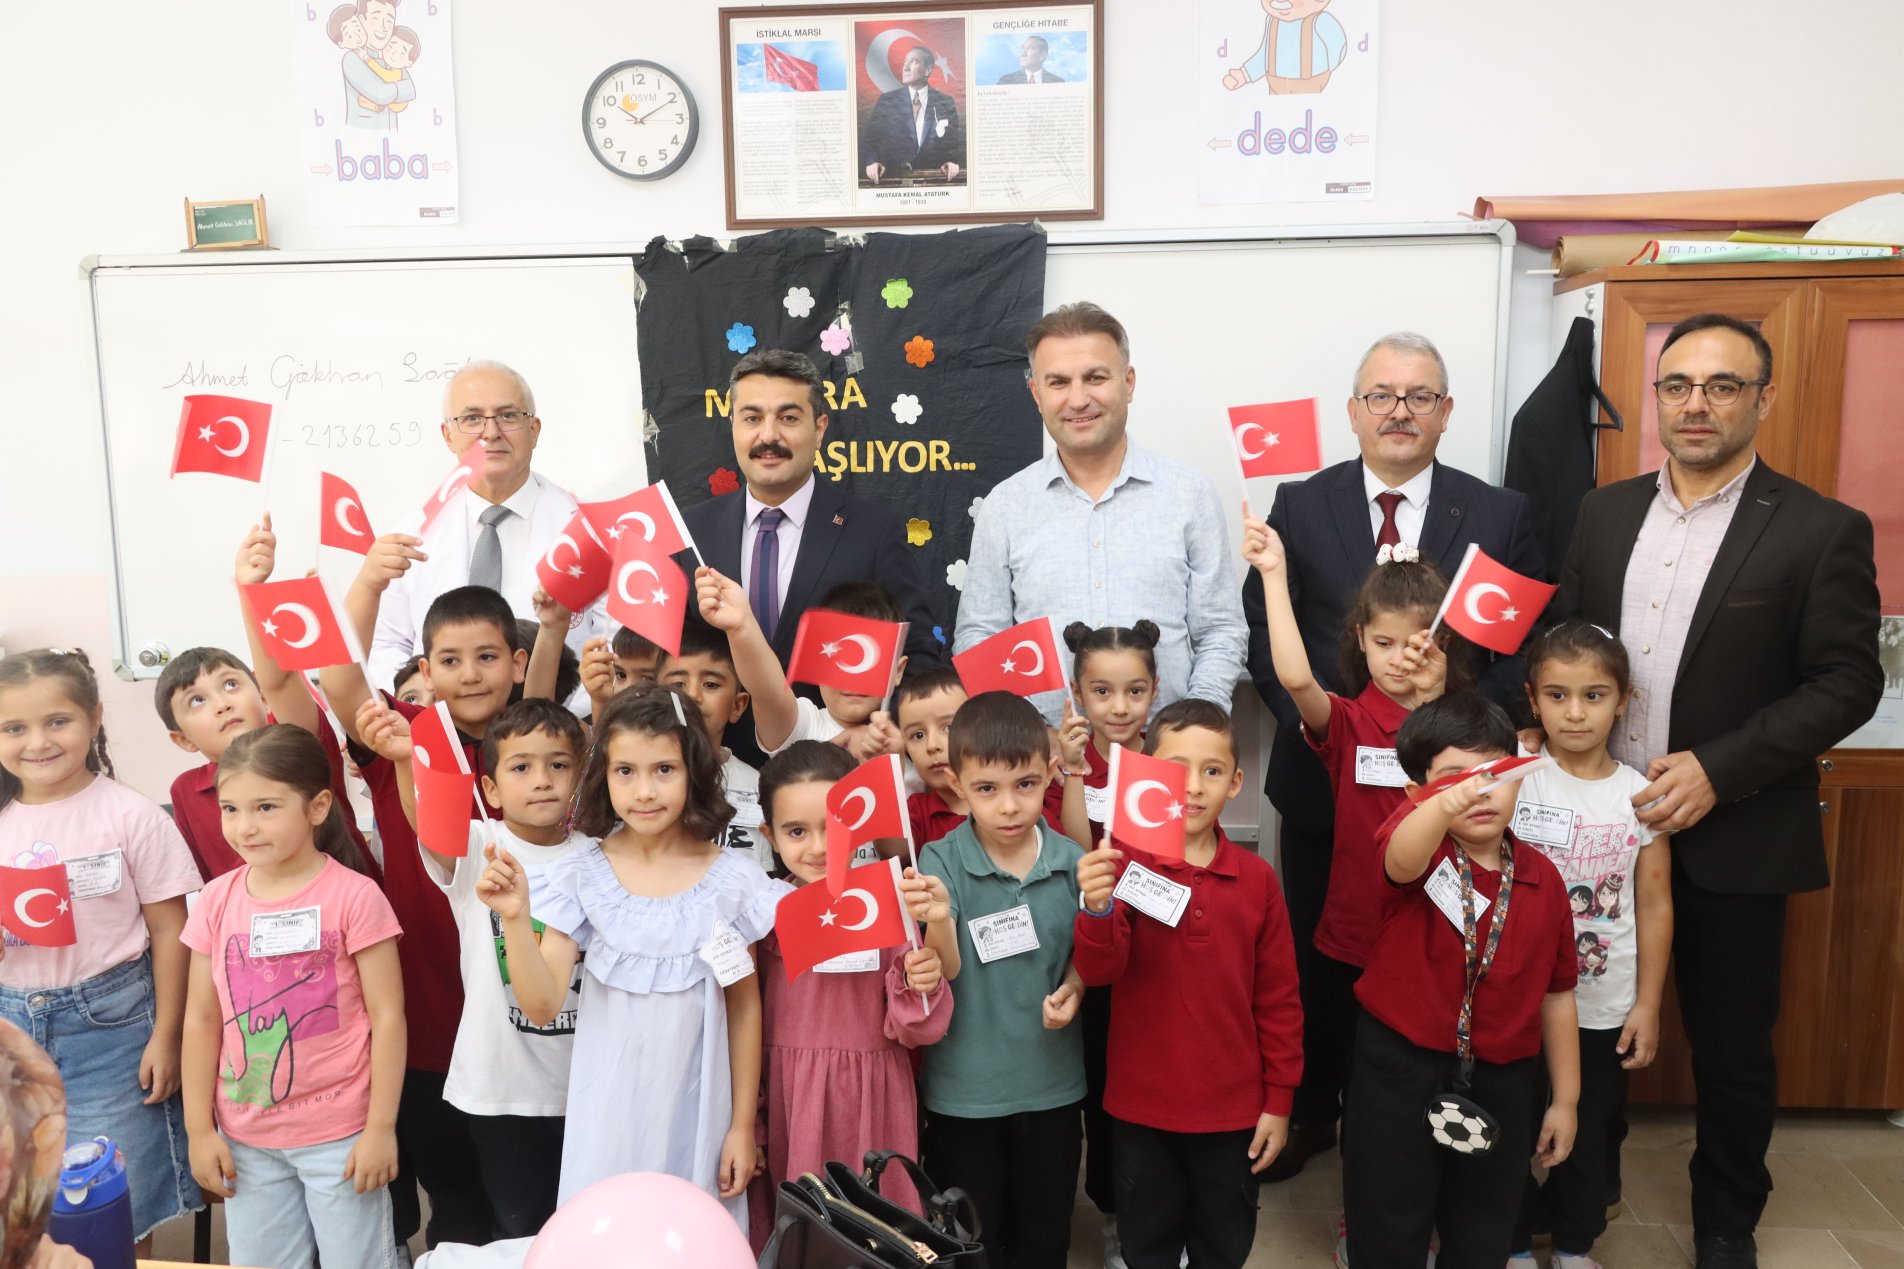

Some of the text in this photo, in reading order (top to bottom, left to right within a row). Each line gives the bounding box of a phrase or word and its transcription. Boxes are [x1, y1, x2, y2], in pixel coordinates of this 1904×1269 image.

[992, 17, 1069, 30] GENÇLİĞE HİTABE
[756, 28, 821, 38] İSTİKLAL MARŞI
[632, 73, 646, 85] 12
[657, 78, 661, 90] 1
[615, 80, 624, 92] 11
[603, 95, 617, 107] 10
[667, 92, 677, 104] 2
[596, 117, 607, 129] 9
[675, 113, 685, 125] 3
[1237, 108, 1338, 156] dede
[603, 137, 614, 149] 8
[671, 134, 680, 146] 4
[335, 137, 429, 182] baba
[617, 151, 627, 163] 7
[637, 155, 648, 167] 6
[658, 149, 668, 161] 5
[162, 359, 249, 389] Ahmet
[224, 934, 338, 1104] Stay
[315, 1090, 341, 1103] MOR
